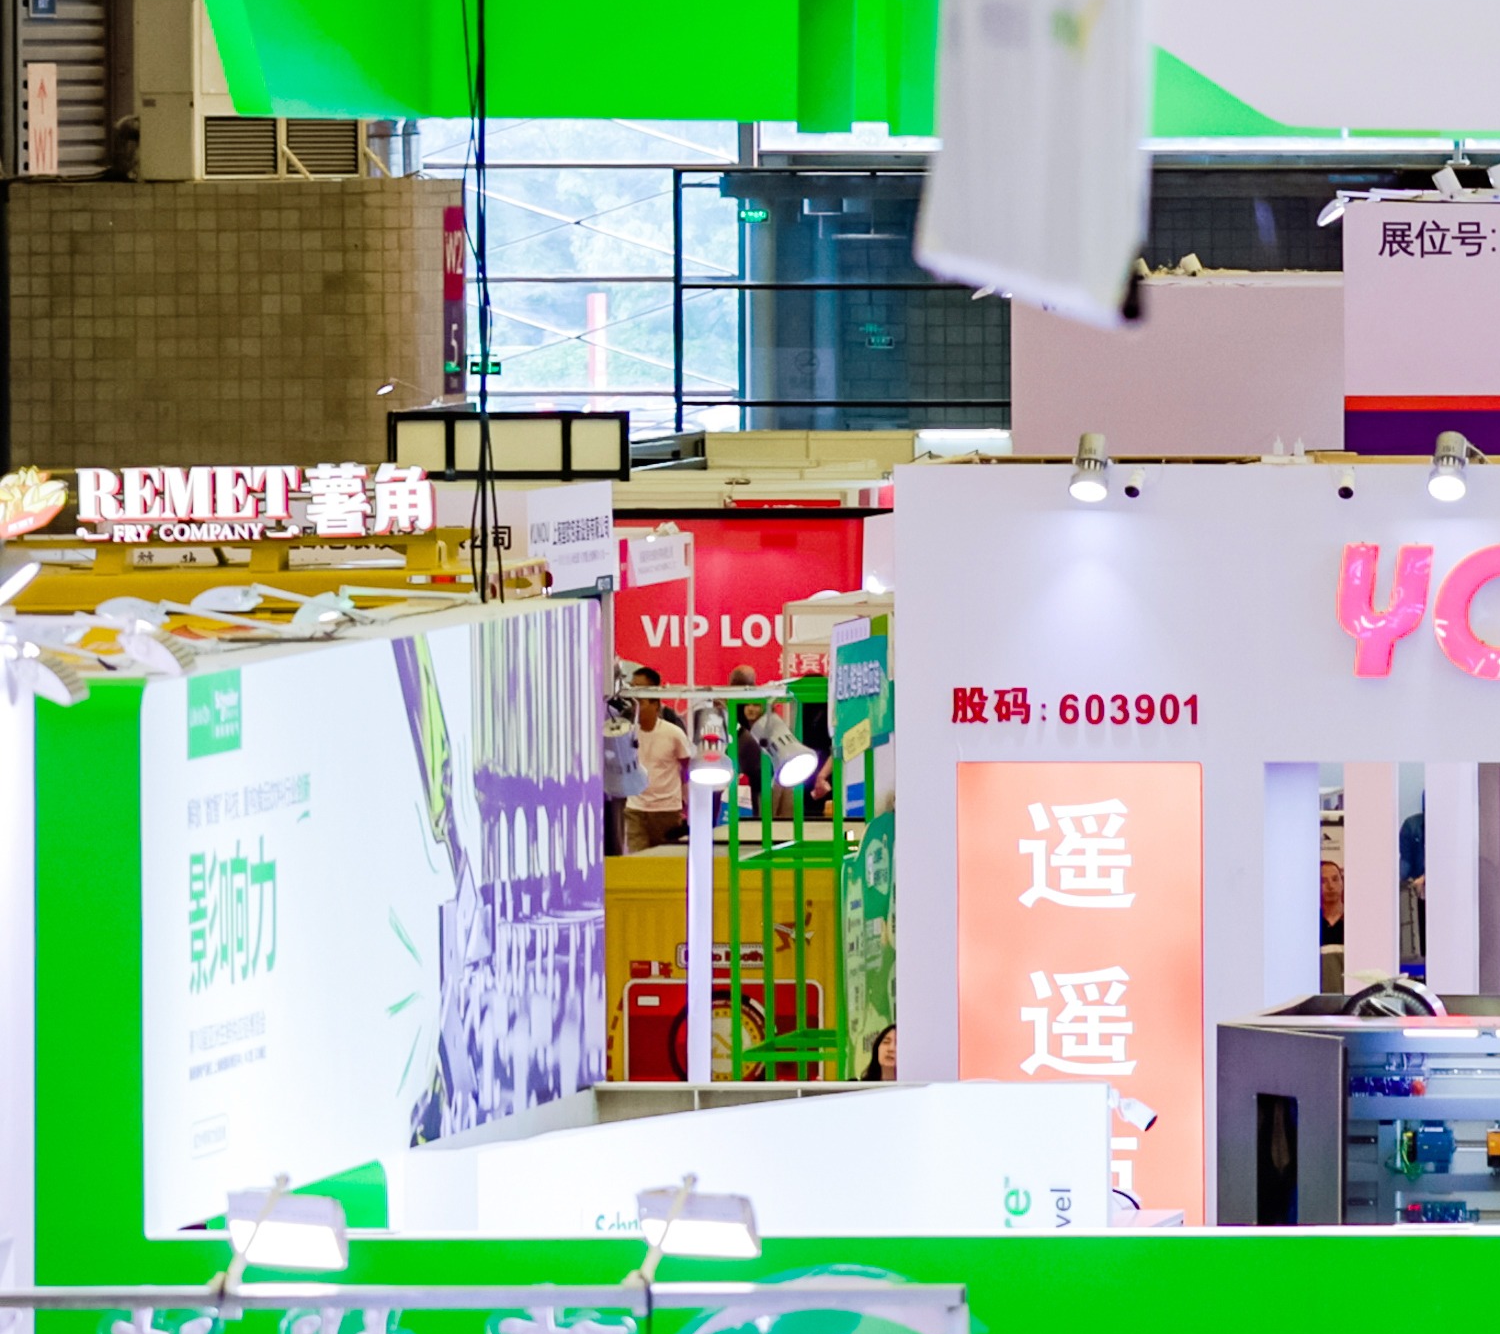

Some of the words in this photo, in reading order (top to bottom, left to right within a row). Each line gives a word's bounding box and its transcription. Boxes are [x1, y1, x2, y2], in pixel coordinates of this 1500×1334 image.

[444, 232, 465, 275] W2
[75, 464, 300, 522] REMET
[303, 460, 437, 538] 薯角
[112, 523, 152, 543] FRY
[158, 522, 265, 543] COMPANY
[641, 614, 709, 648] VIP
[720, 613, 797, 648] LOU
[1058, 693, 1200, 726] 603901
[188, 834, 277, 996] 影响力
